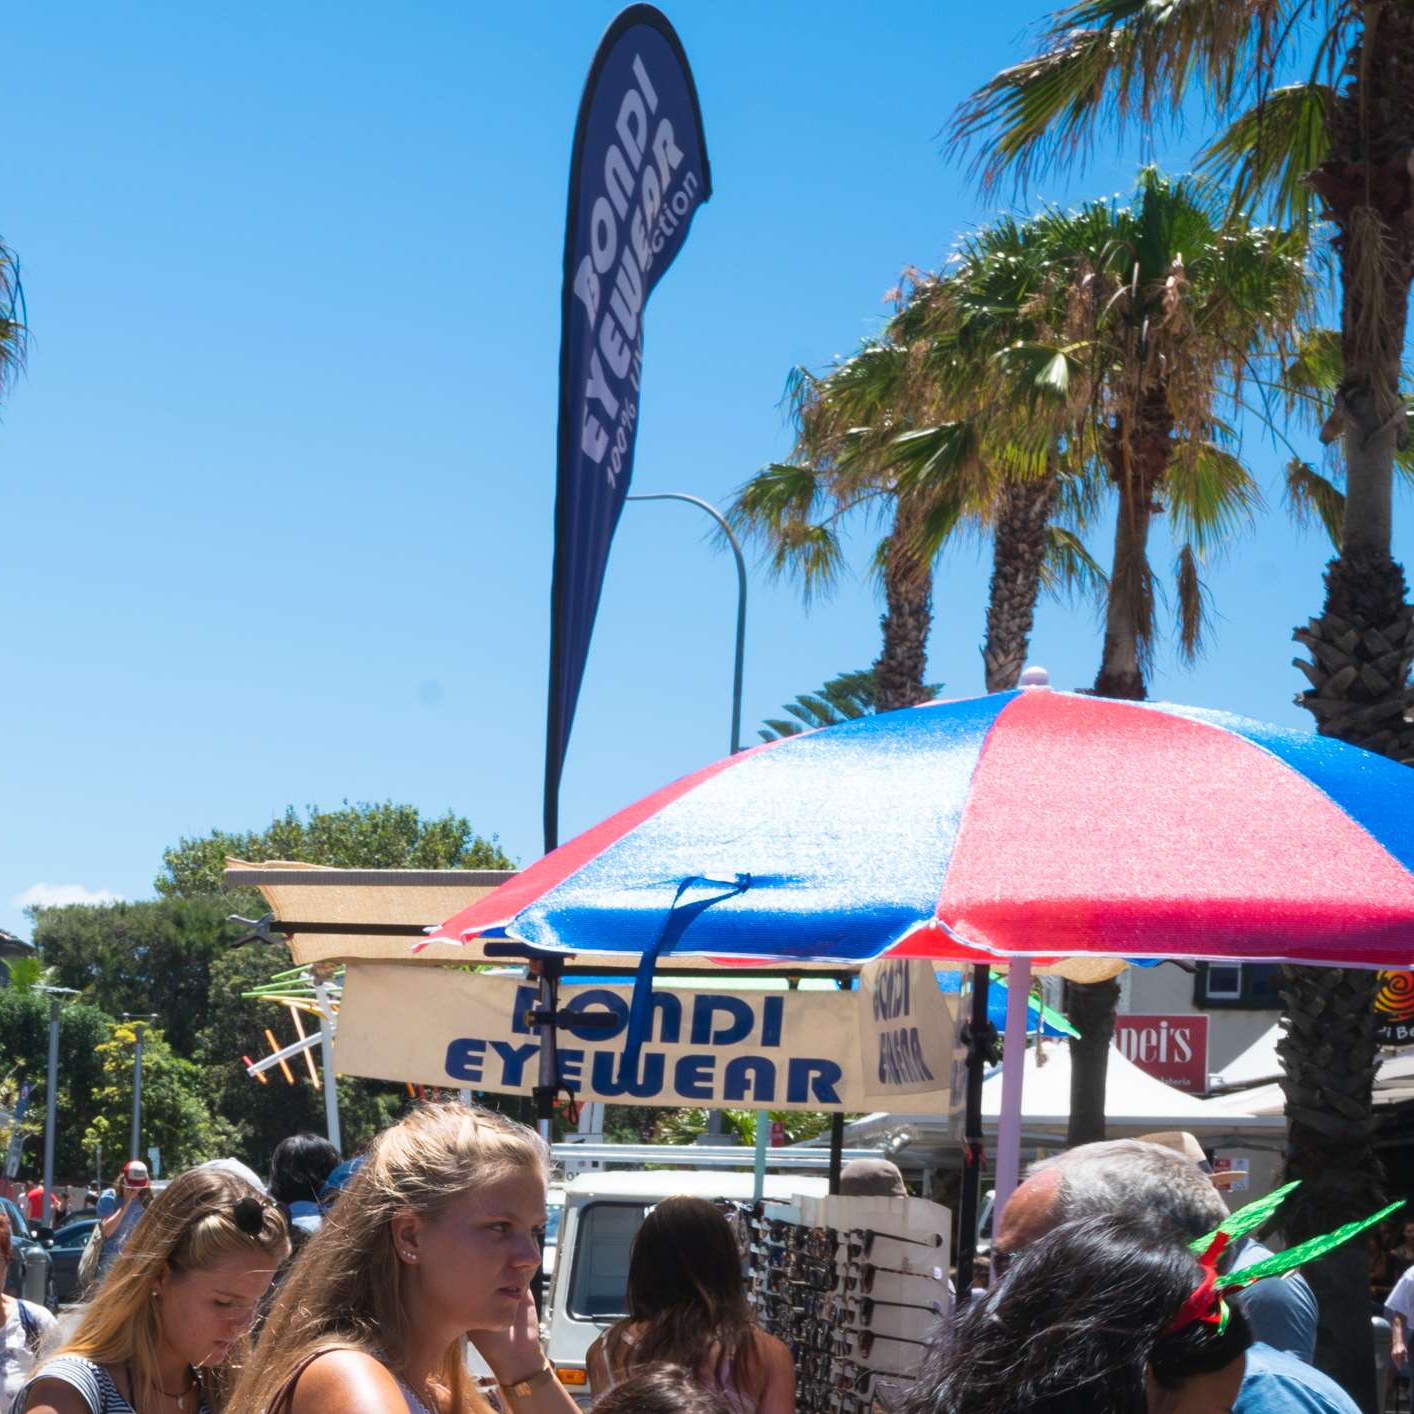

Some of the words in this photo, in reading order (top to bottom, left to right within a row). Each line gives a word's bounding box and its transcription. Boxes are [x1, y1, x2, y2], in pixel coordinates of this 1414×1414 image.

[573, 53, 659, 333] BONDI
[581, 118, 685, 463] EYEWEAR
[1114, 1020, 1192, 1063] pei's
